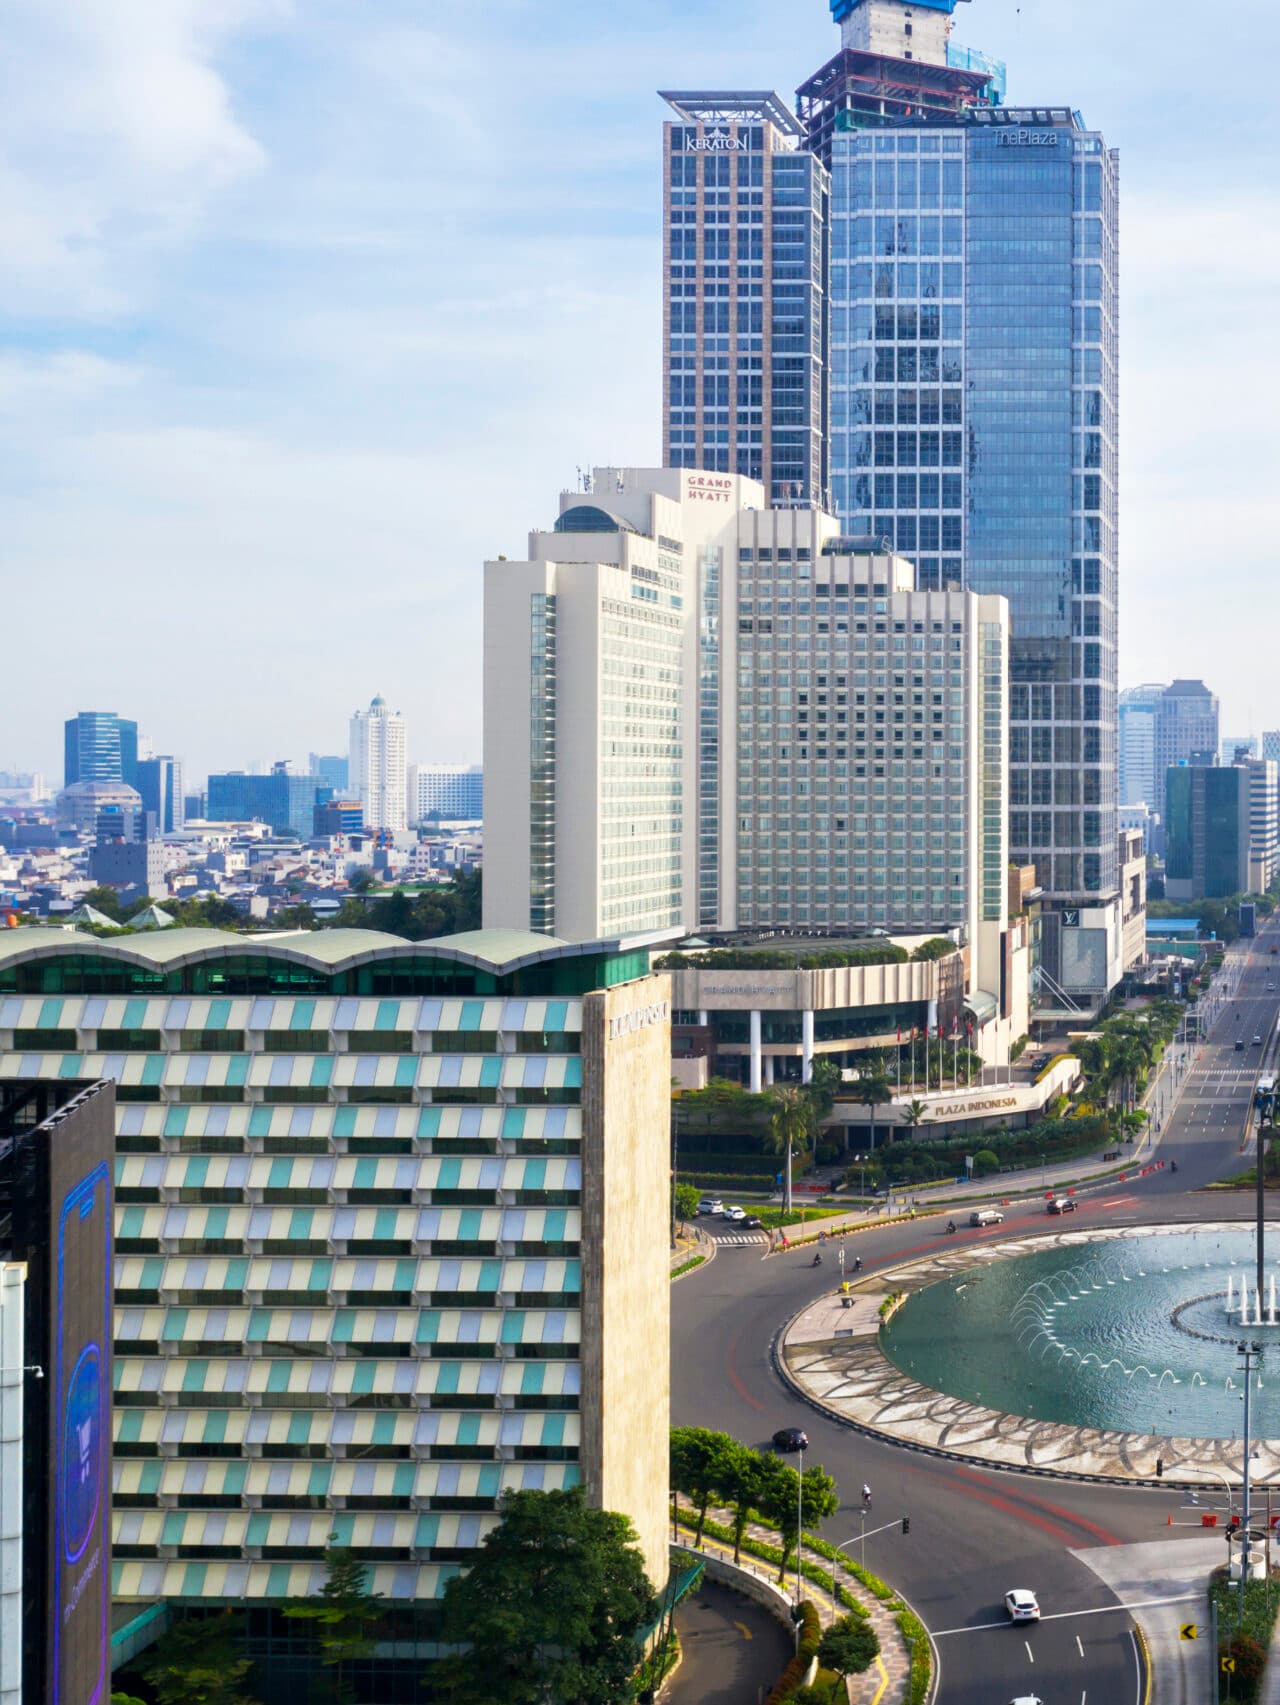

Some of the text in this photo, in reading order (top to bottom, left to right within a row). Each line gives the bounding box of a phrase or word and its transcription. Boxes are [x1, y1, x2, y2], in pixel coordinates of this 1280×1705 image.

[686, 133, 748, 152] KERATON
[688, 476, 732, 488] GRAND
[689, 490, 731, 502] HYATT
[936, 1098, 1016, 1115] PLAZA INDONESIA
